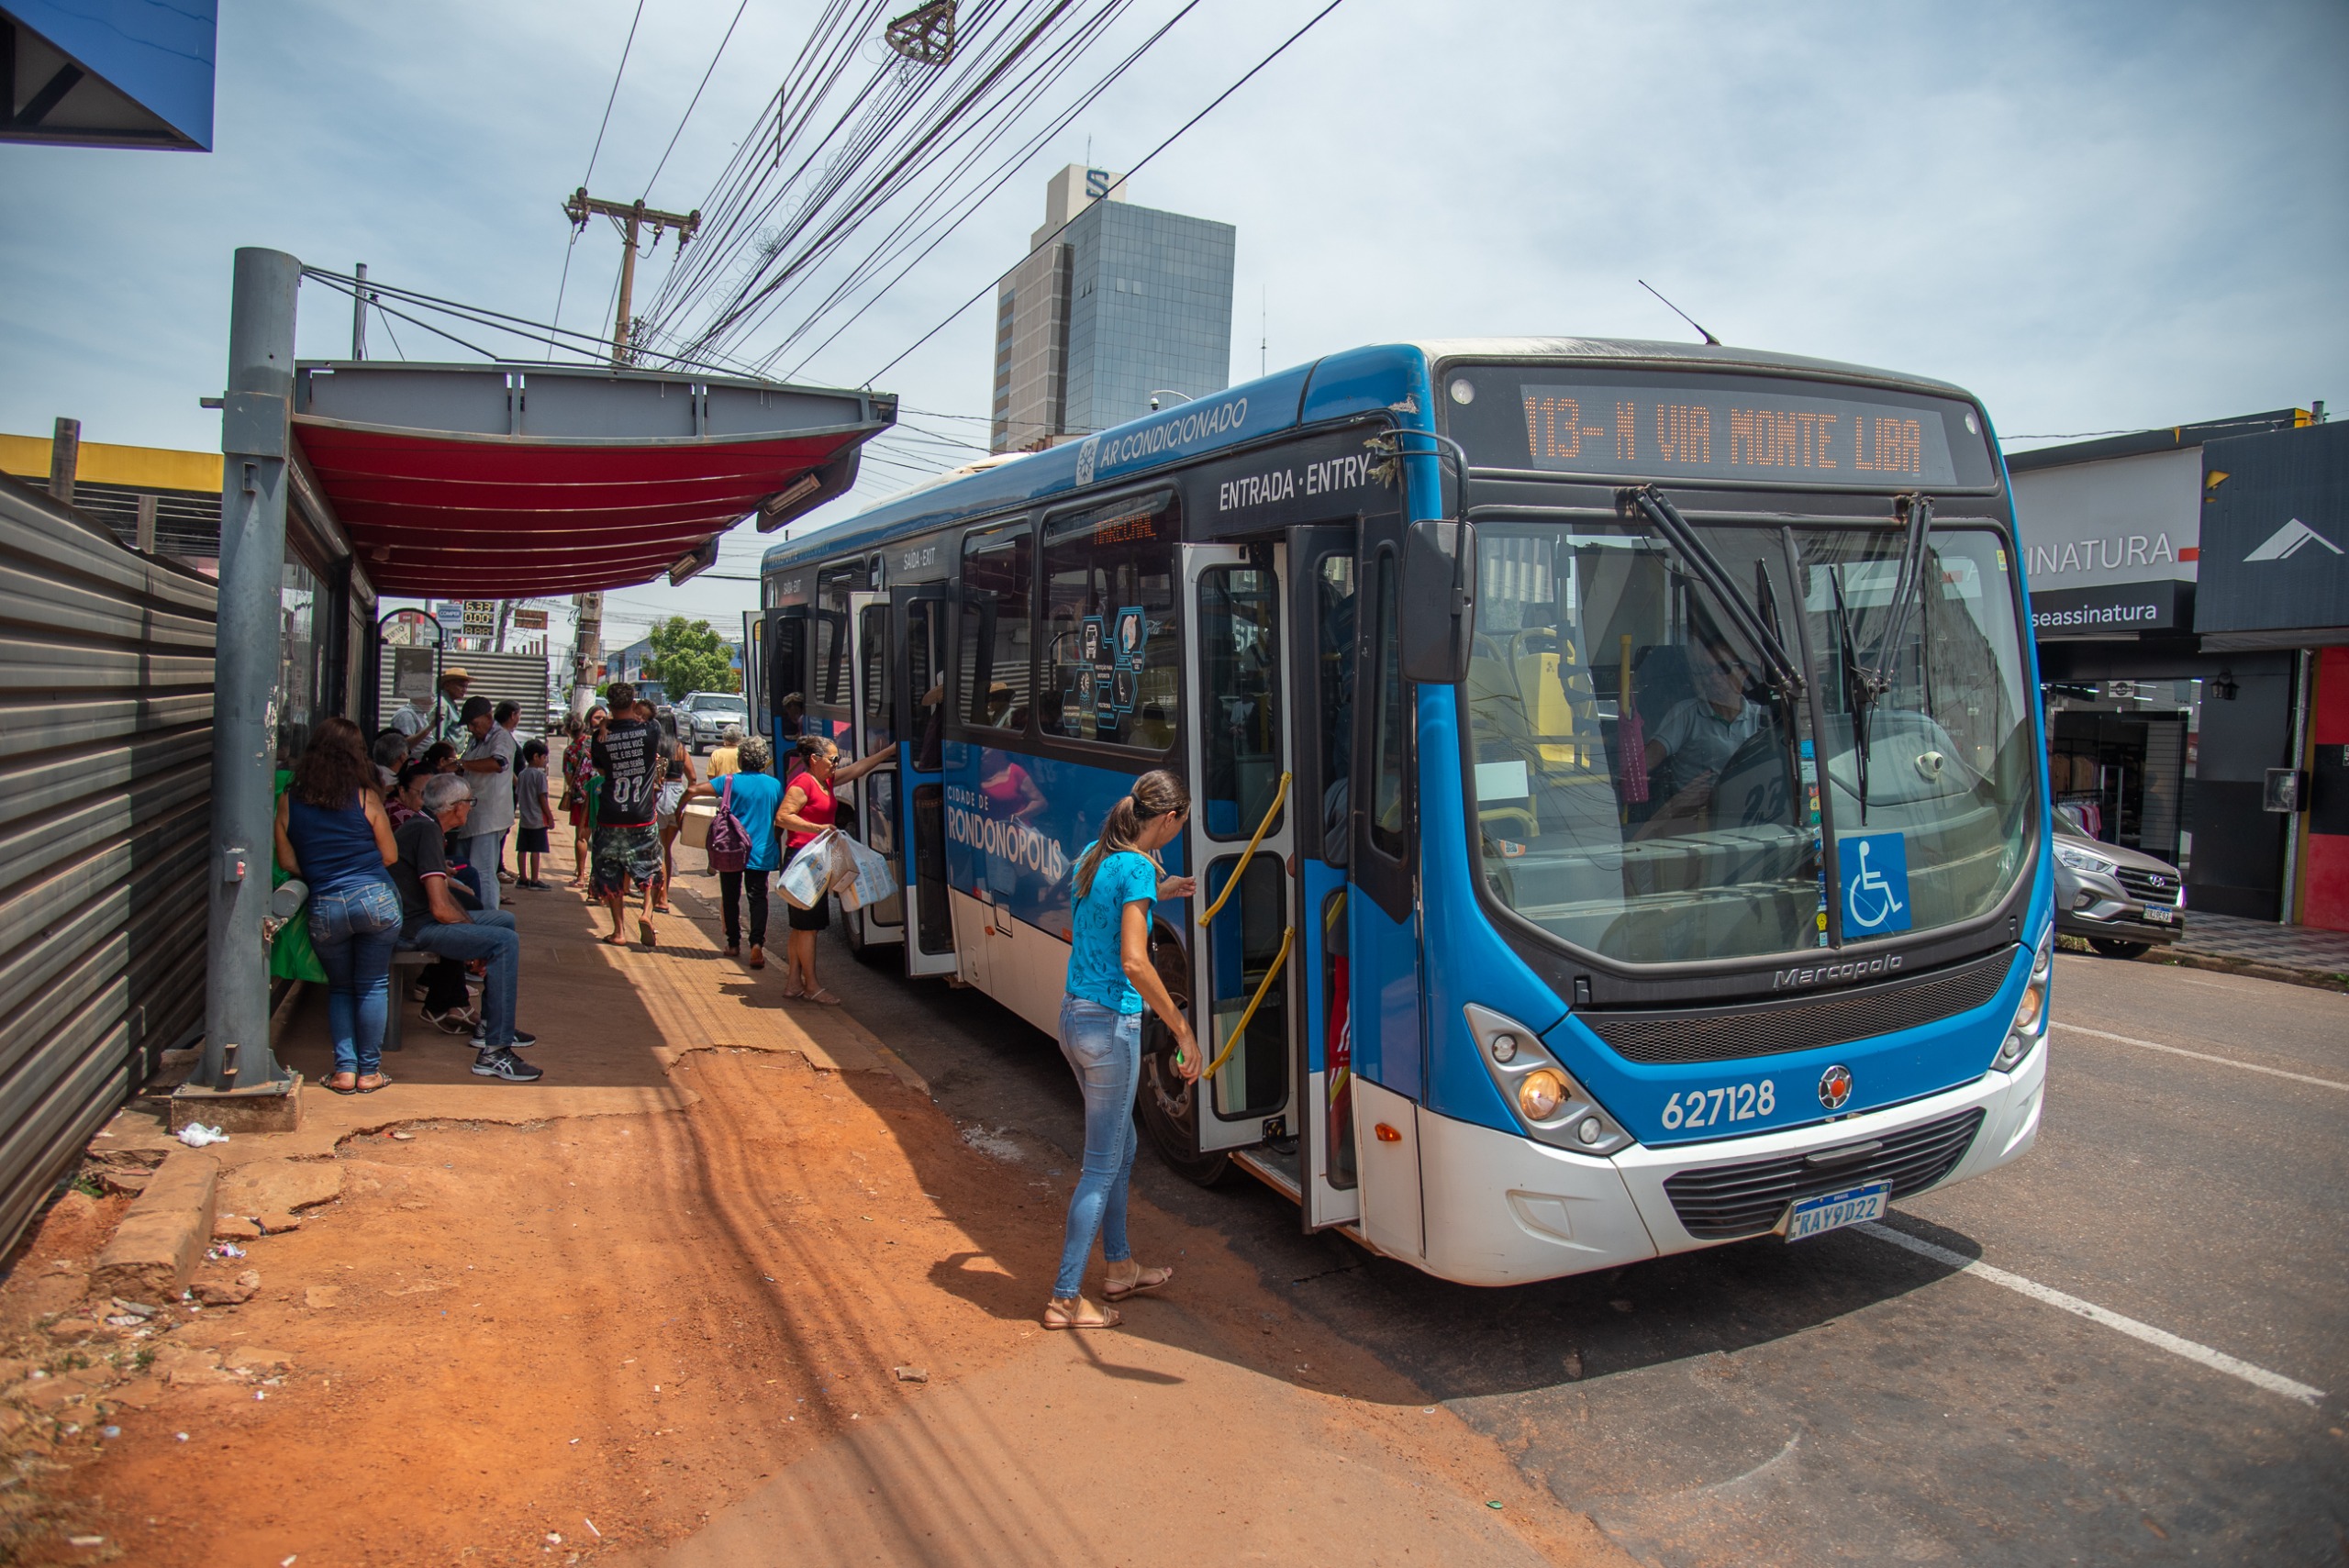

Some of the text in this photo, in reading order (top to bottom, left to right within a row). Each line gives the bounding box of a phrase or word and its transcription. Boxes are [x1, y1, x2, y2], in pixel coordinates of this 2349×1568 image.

[1100, 397, 1248, 468] AR CONDICIONADO
[1657, 404, 1710, 462] VIA
[1731, 408, 1836, 468] MONTE
[1856, 417, 1920, 472] LIBA
[1219, 452, 1372, 512] ENTRADA ENTRY
[1094, 512, 1157, 545] MARECHAL
[922, 547, 936, 566] EXIT
[2022, 532, 2174, 576] INATURA
[623, 740, 632, 749] QUE
[632, 739, 644, 748] VOCÊ
[629, 728, 647, 739] SENHOR
[631, 748, 643, 757] SEUS
[613, 775, 643, 804] 01
[947, 785, 989, 811] CIDADE DE
[947, 806, 1062, 881] RONDONÓPOLIS
[1772, 953, 1903, 992] Marcopolo
[1662, 1079, 1776, 1130] 627128
[1798, 1196, 1878, 1236] RAY9D22
